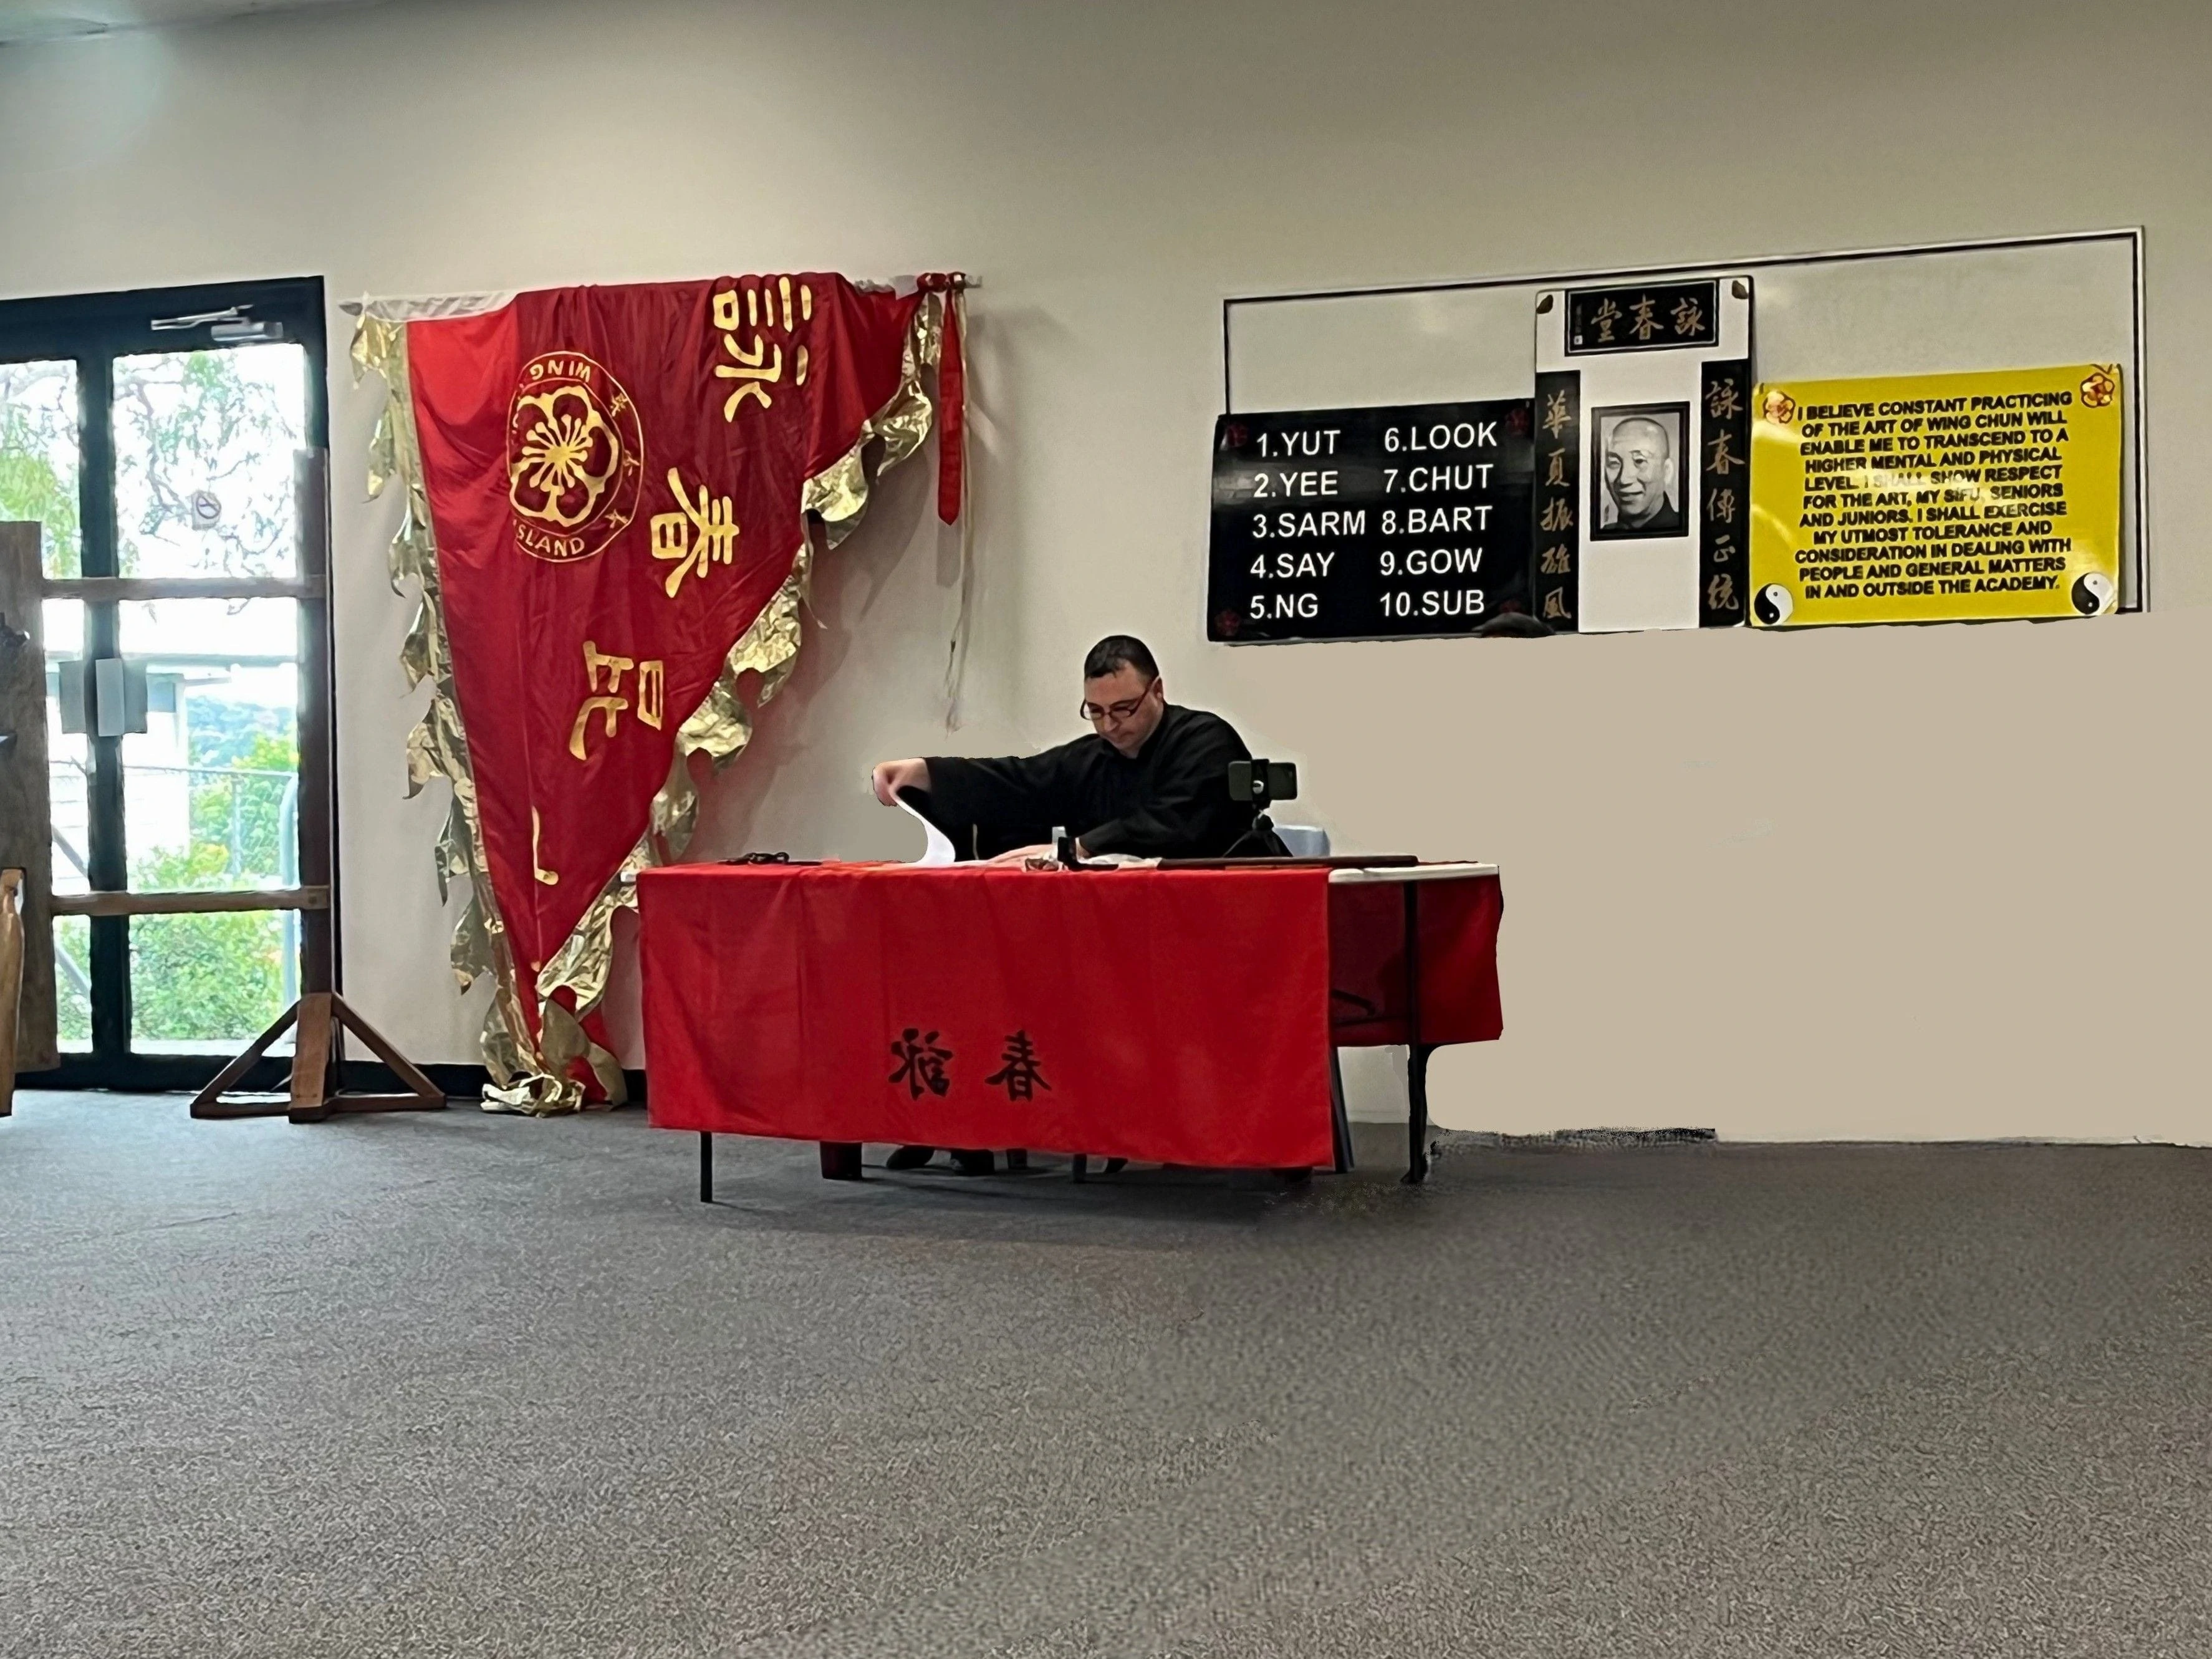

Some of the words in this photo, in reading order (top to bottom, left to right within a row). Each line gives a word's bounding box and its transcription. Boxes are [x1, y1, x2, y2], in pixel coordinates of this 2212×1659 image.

[529, 360, 591, 383] WING
[1798, 406, 1802, 421] I
[1807, 403, 1875, 420] BELIEVE
[1878, 398, 1967, 416] CONSTANT
[1971, 392, 2072, 411] PRACTICING
[1385, 422, 1497, 451] 6.LOOK
[1802, 423, 1824, 438] OF
[1828, 421, 1860, 436] THE
[1863, 420, 1897, 435] ART
[1900, 418, 1923, 433] OF
[1927, 415, 1971, 431] WING
[1975, 412, 2022, 428] CHUN
[2027, 410, 2067, 425] WILL
[1257, 430, 1340, 457] 1.YUT
[1801, 439, 1865, 456] ENABLE
[1870, 438, 1893, 452] ME
[1897, 436, 1920, 450] TO
[1923, 431, 2026, 449] TRANSCEND
[2030, 429, 2053, 443] TO
[2056, 428, 2069, 442] A
[1806, 457, 1867, 474] HIGHER
[1871, 453, 1937, 469] MENTAL
[1940, 451, 1975, 466] AND
[1979, 446, 2062, 464] PHYSICAL
[1254, 471, 1338, 498] 2.YEE
[1384, 464, 1493, 493] 7.CHUT
[1864, 475, 1868, 488] I
[1931, 468, 1981, 484] SHOW
[1985, 464, 2062, 482] RESPECT
[1804, 494, 1837, 509] FOR
[1840, 493, 1872, 507] THE
[1916, 489, 1940, 504] MY
[1990, 483, 2063, 499] SENIORS
[1253, 511, 1365, 537] 3.SARM
[1382, 506, 1493, 534] 8.BART
[1800, 513, 1834, 527] AND
[1837, 509, 1913, 526] JUNIORS.
[1918, 508, 1922, 522] I
[1926, 506, 1981, 521] SHALL
[1984, 501, 2067, 519] EXERCISE
[1814, 531, 1837, 544] MY
[1841, 527, 1908, 544] UTMOST
[1912, 522, 2012, 540] TOLERANCE
[2016, 521, 2052, 536] AND
[1380, 548, 1483, 575] 9.GOW
[1795, 544, 1926, 564] CONSIDERATION
[1931, 544, 1947, 558] IN
[1951, 541, 2024, 557] DEALING
[2029, 538, 2071, 553] WITH
[1251, 552, 1335, 578] 4.SAY
[1800, 565, 1863, 582] PEOPLE
[1867, 564, 1902, 579] AND
[1906, 560, 1984, 577] GENERAL
[1989, 557, 2065, 574] MATTERS
[1806, 585, 1821, 599] IN
[1824, 584, 1859, 598] AND
[1863, 580, 1934, 597] OUTSIDE
[1938, 579, 1971, 594] THE
[1974, 575, 2060, 592] ACADEMY.
[1250, 594, 1318, 619] 5.NG
[1380, 590, 1484, 617] 10.SUB
